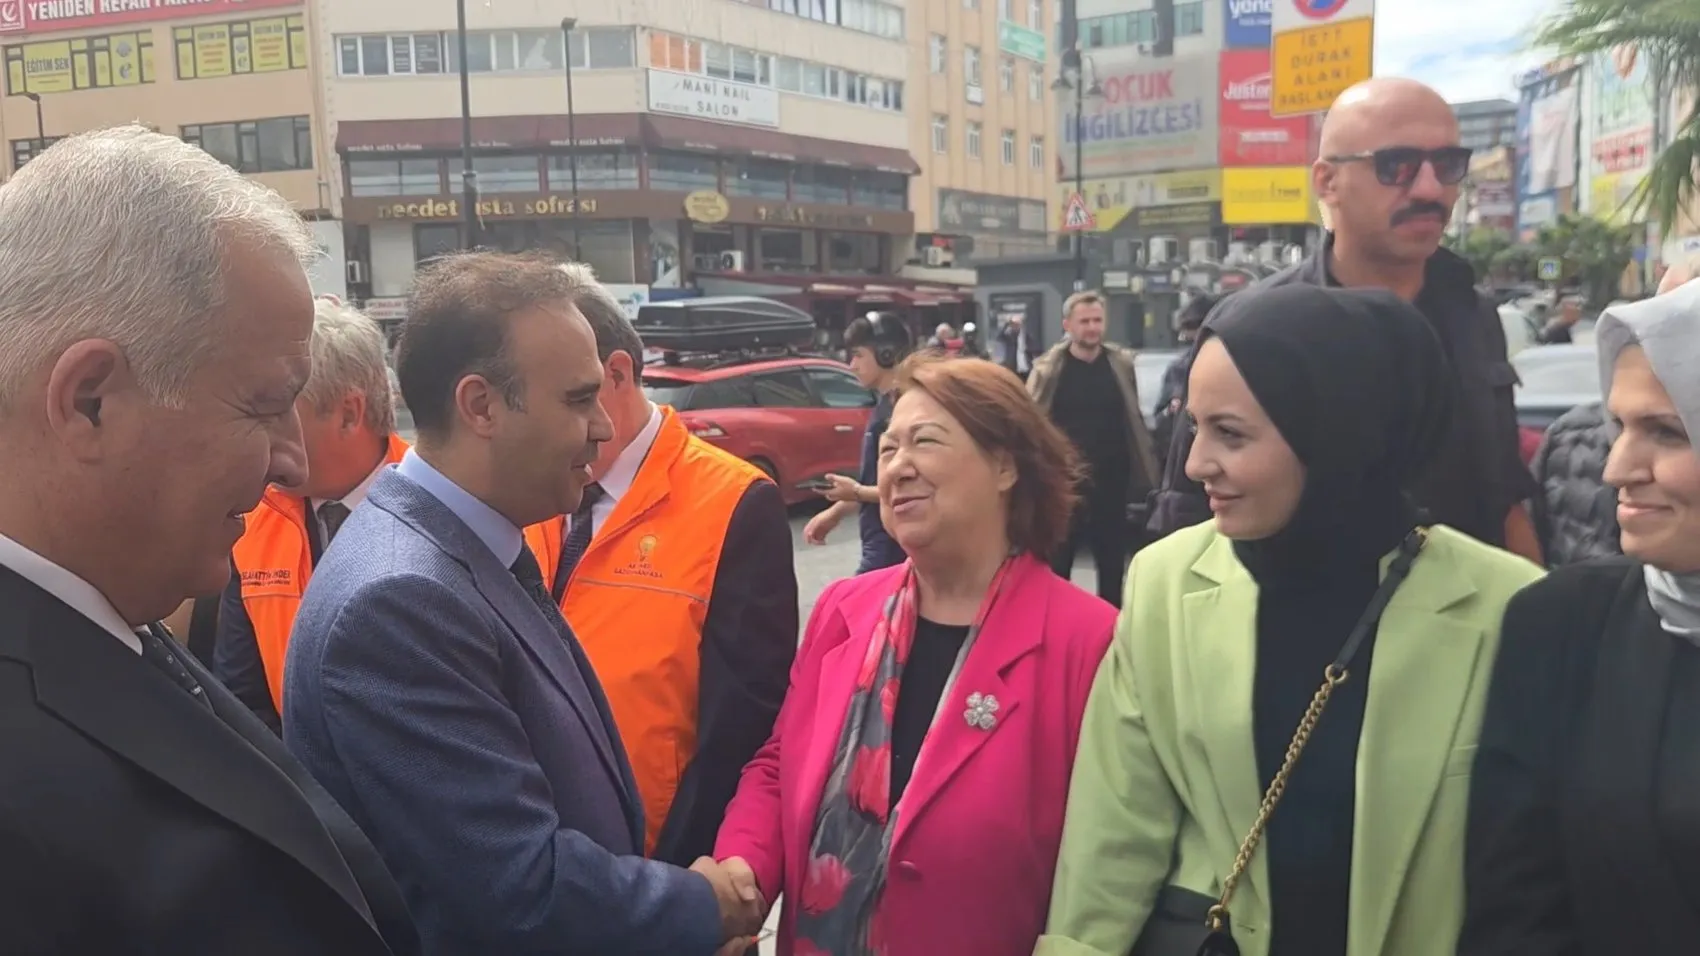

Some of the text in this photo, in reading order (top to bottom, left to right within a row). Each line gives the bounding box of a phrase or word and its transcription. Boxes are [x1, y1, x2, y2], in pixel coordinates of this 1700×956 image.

[1290, 46, 1351, 69] DURAK
[1100, 70, 1174, 104] OCUK
[697, 100, 739, 117] SALON
[378, 198, 459, 218] necdet
